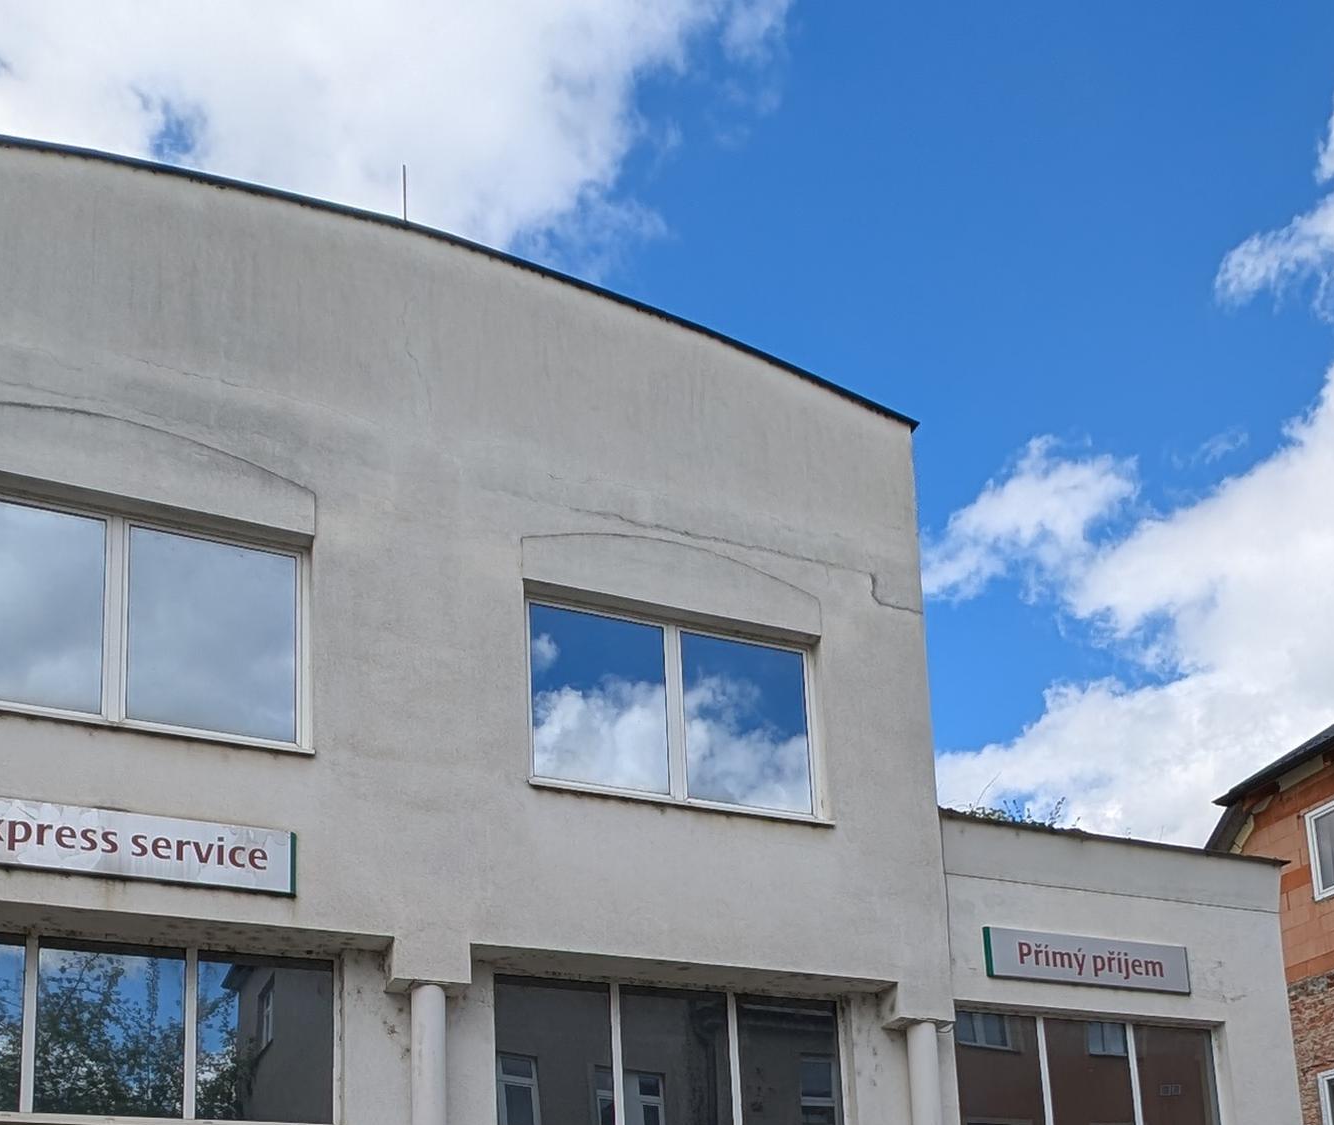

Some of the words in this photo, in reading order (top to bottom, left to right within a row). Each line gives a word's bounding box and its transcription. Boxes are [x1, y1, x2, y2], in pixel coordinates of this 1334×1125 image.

[130, 834, 269, 871] service
[1018, 941, 1086, 976] Přímý
[1092, 950, 1165, 980] příjem
